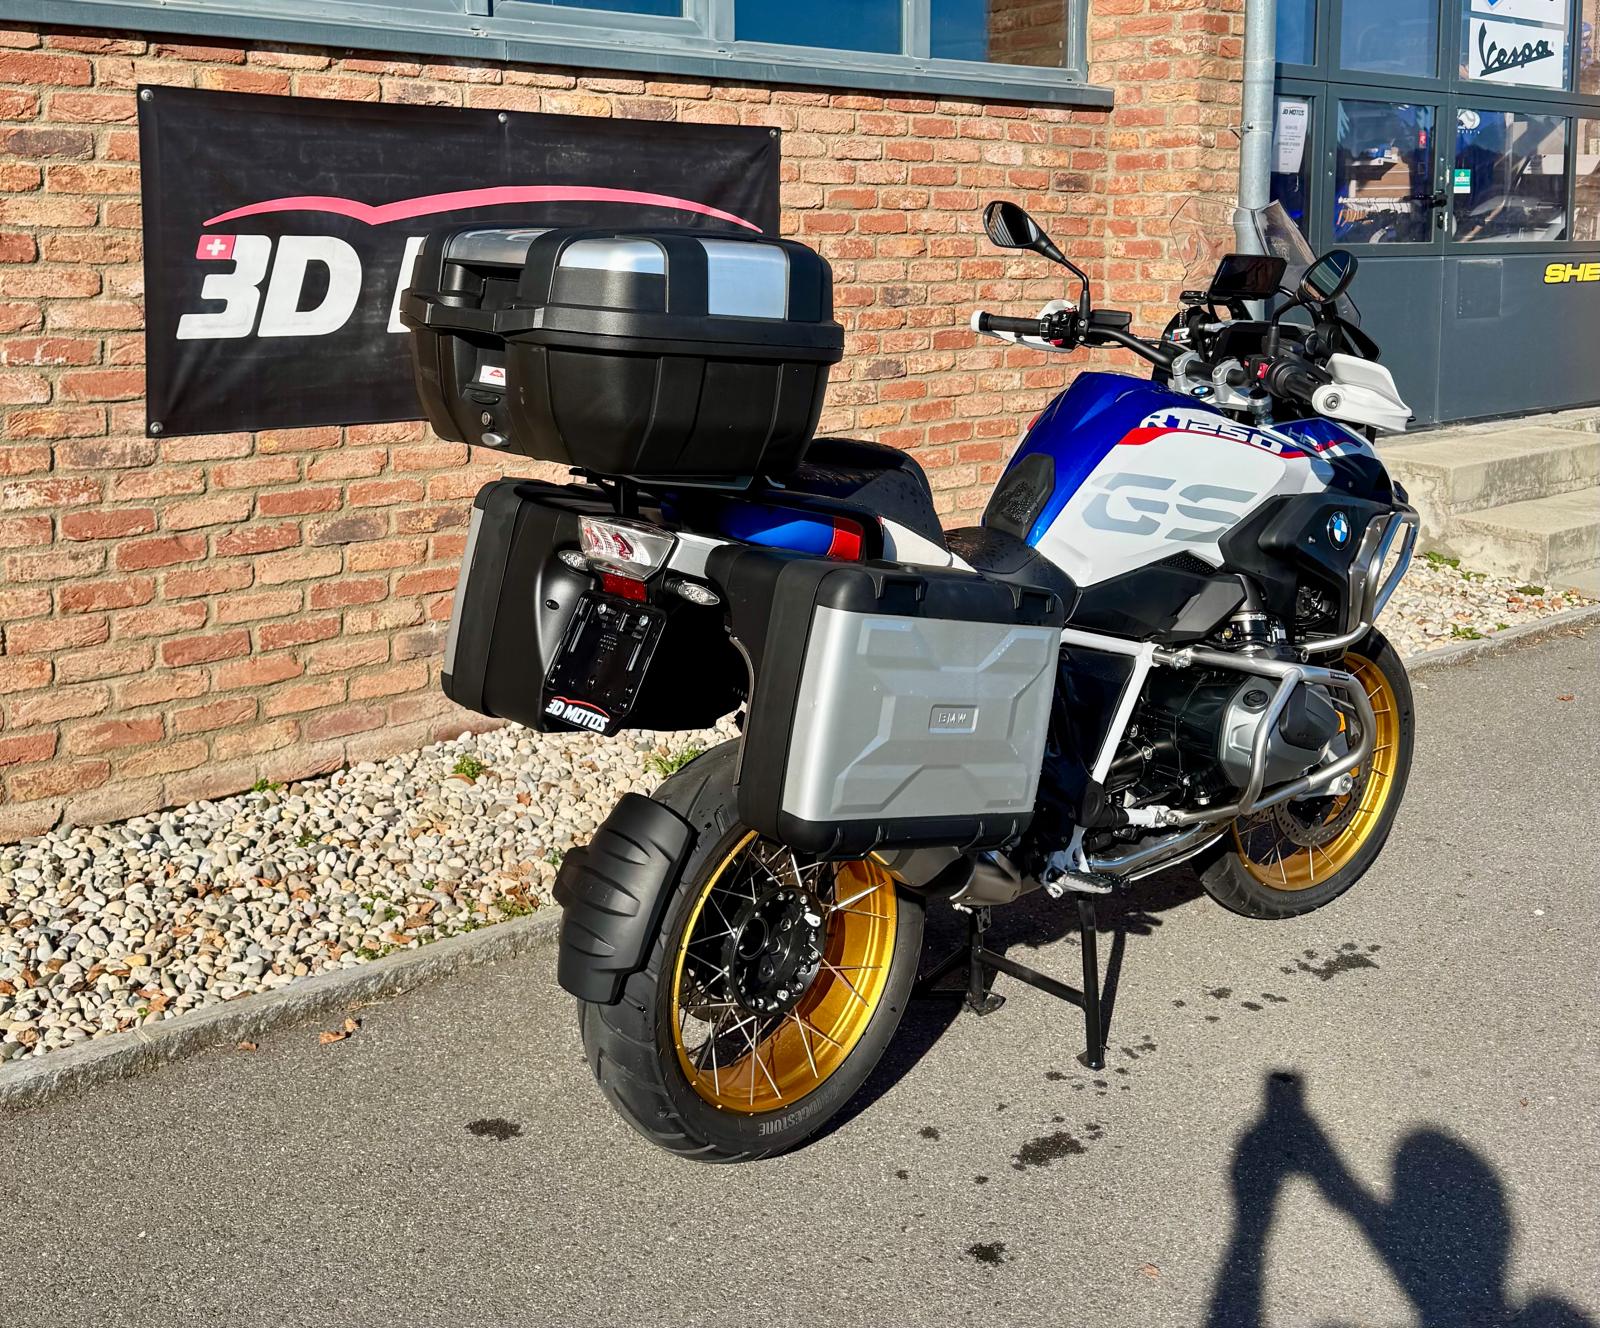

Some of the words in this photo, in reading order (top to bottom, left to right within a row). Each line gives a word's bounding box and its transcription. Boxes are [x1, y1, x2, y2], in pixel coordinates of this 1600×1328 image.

[1479, 22, 1554, 76] Vespa
[176, 234, 362, 339] 3D
[1082, 472, 1258, 544] GS
[545, 698, 565, 716] 3D
[562, 704, 610, 732] MOTOS
[938, 712, 967, 724] BMW
